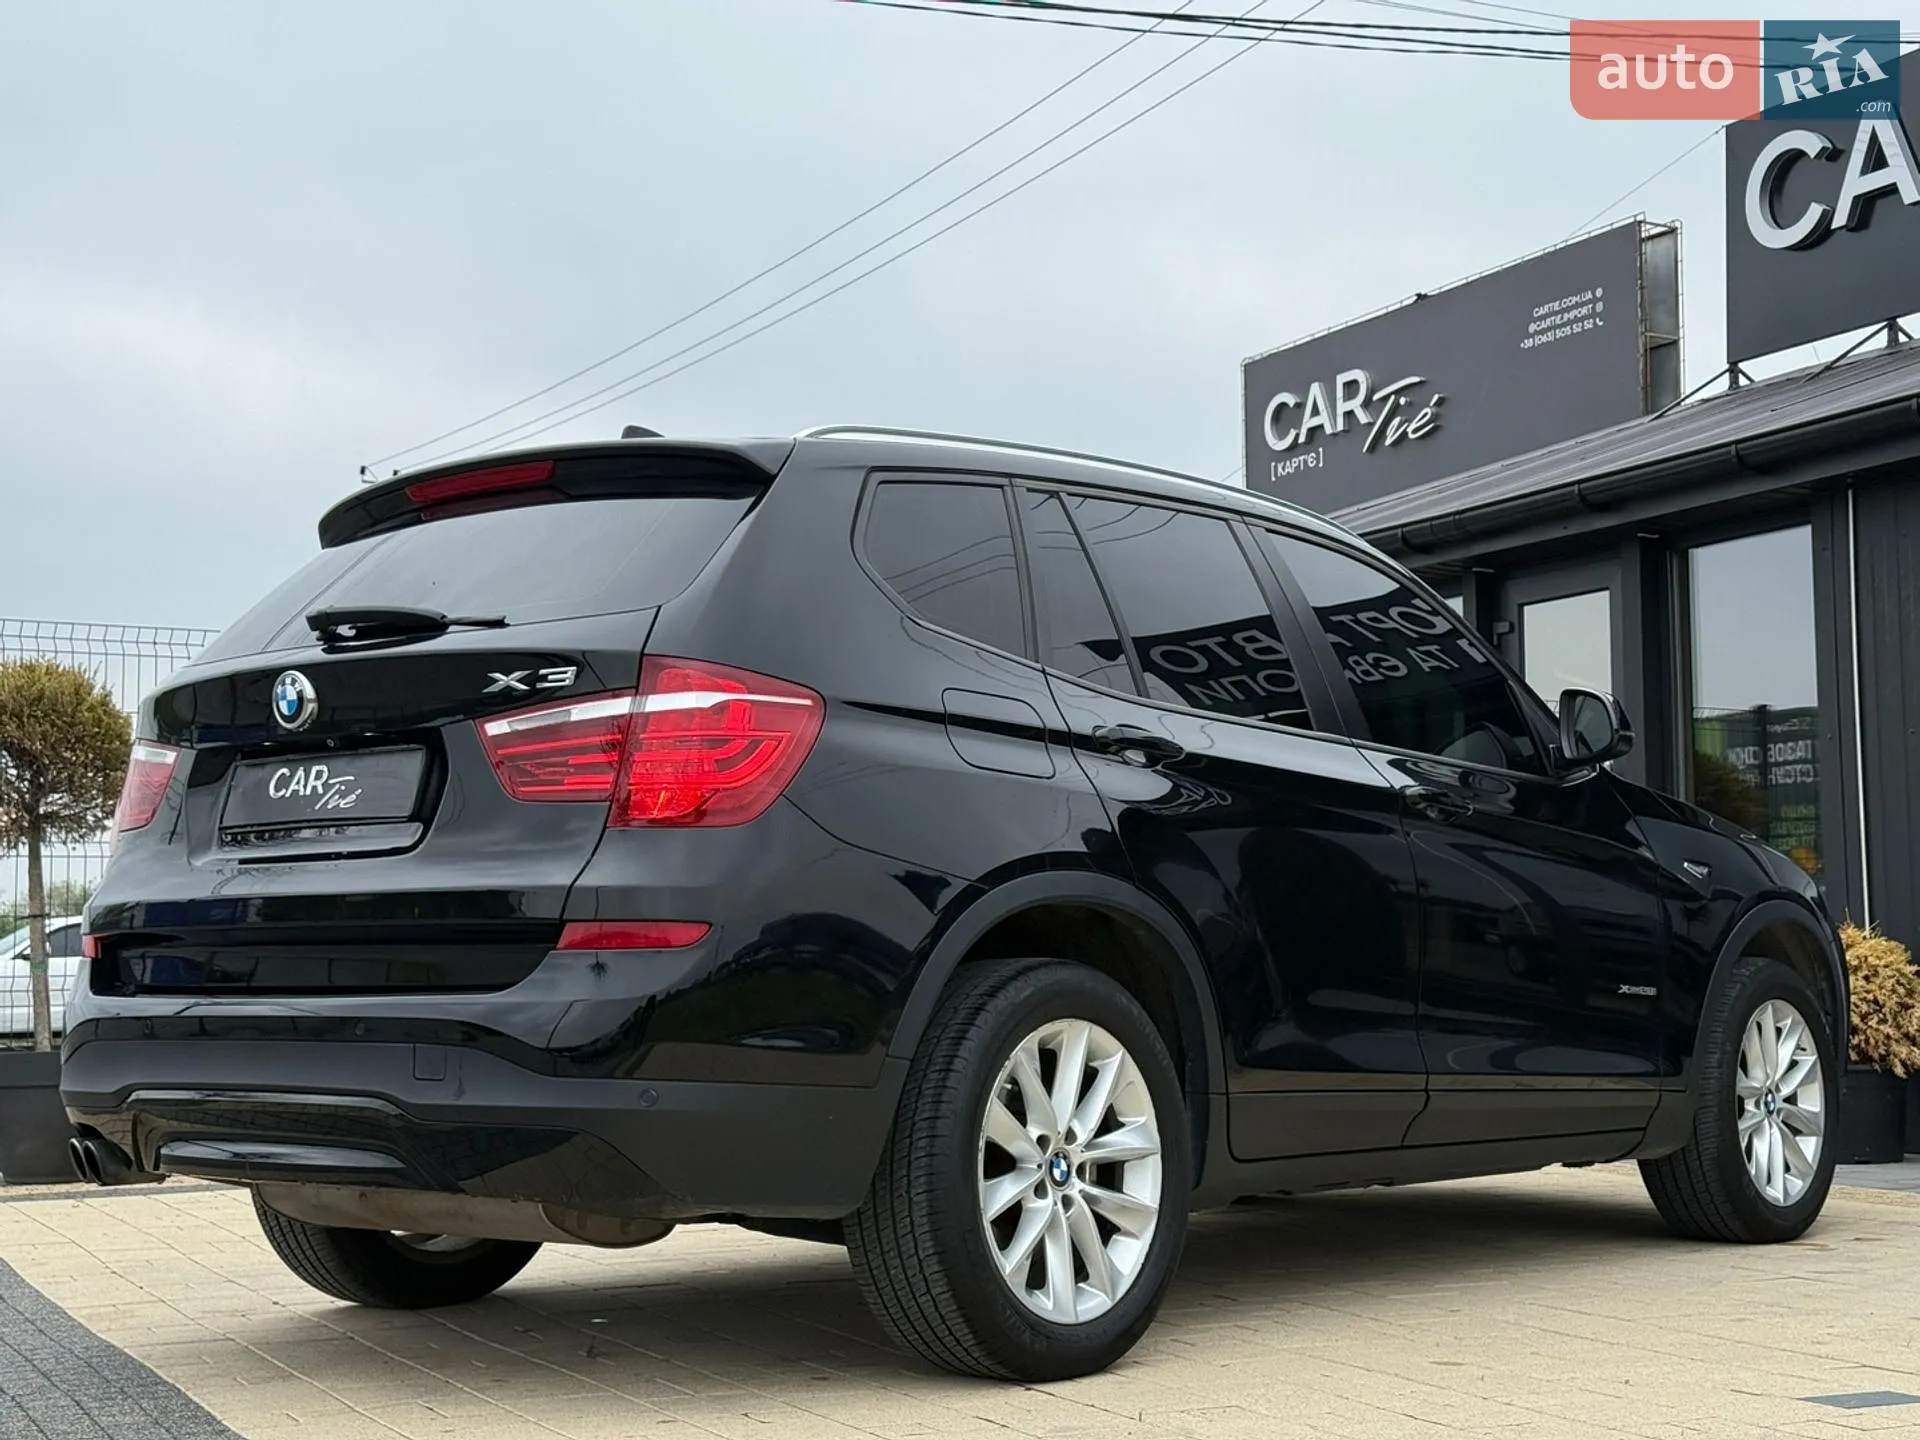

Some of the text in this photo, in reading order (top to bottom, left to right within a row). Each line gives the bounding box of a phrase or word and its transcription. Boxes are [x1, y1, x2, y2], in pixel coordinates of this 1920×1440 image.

[1533, 290, 1593, 317] CARTIE.COM.UA
[1556, 326, 1571, 339] 505
[1573, 322, 1582, 333] 52
[1584, 319, 1594, 330] 52
[1264, 368, 1374, 451] CAR
[482, 666, 577, 693] X3
[269, 765, 329, 799] CAR
